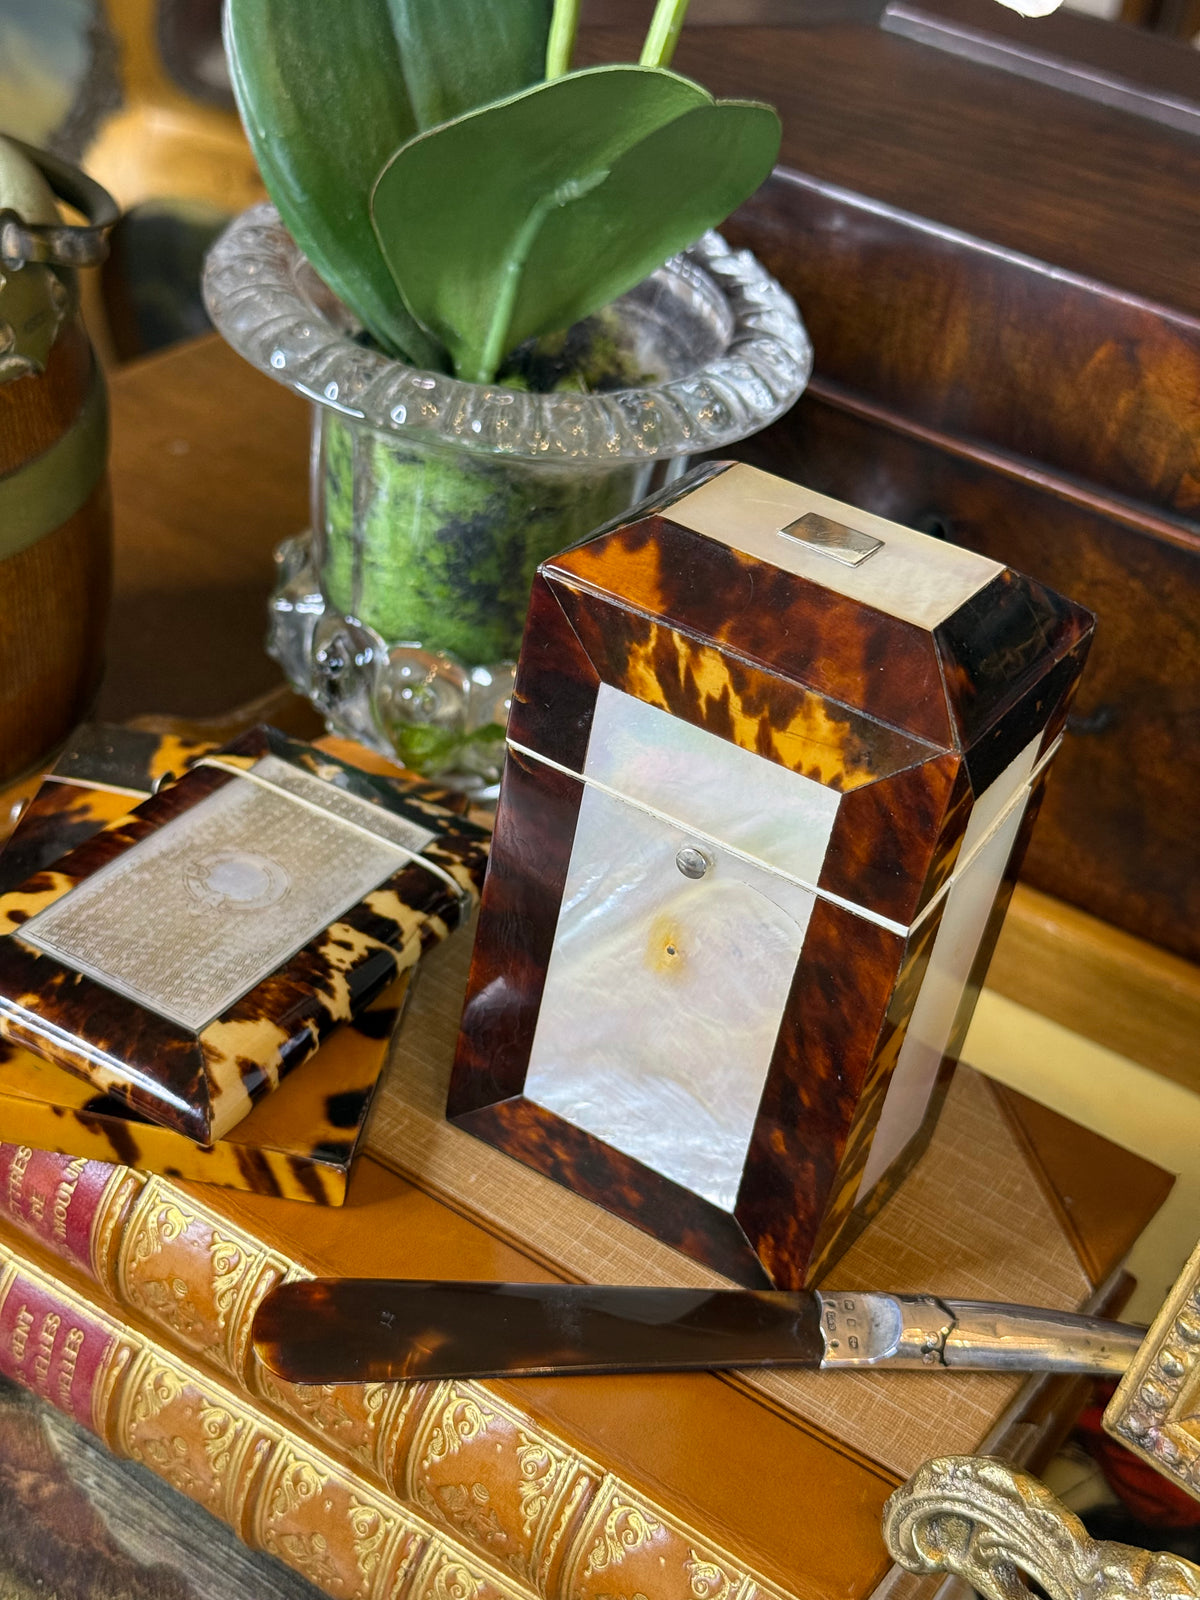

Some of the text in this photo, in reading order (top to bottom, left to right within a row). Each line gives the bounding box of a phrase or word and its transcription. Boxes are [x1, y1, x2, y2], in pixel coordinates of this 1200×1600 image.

[31, 1190, 45, 1220] DE
[54, 1157, 89, 1238] MOULIN
[35, 1312, 61, 1406] UVELLES
[59, 1328, 84, 1417] UVELLES
